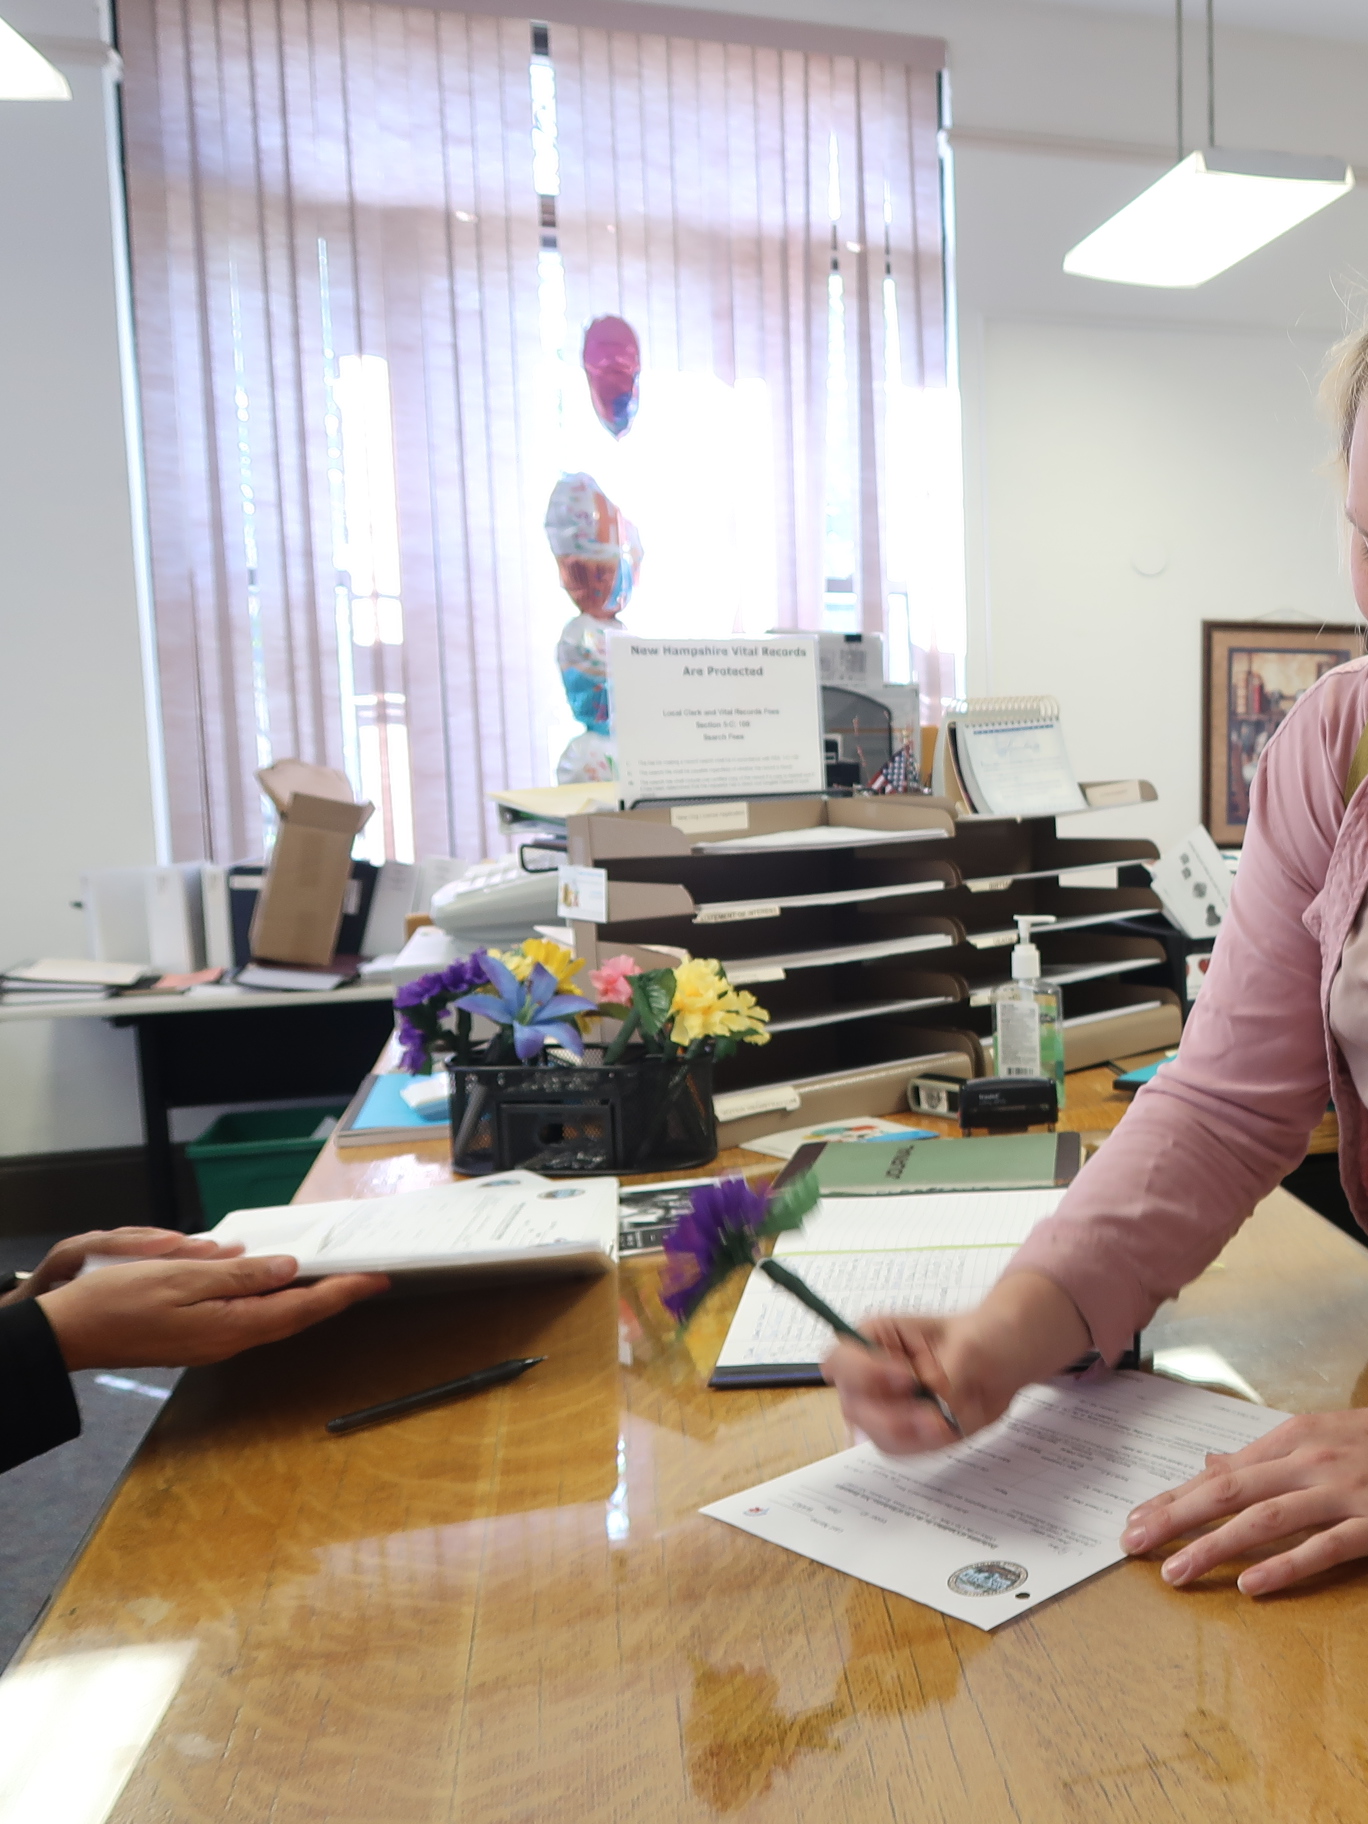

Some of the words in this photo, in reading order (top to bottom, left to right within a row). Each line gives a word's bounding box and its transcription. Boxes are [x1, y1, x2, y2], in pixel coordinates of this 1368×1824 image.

[631, 645, 658, 655] New
[662, 645, 728, 657] Hampshire
[731, 646, 758, 656] Vital
[761, 646, 807, 657] Records
[683, 666, 703, 676] Are
[707, 666, 763, 676] Protected
